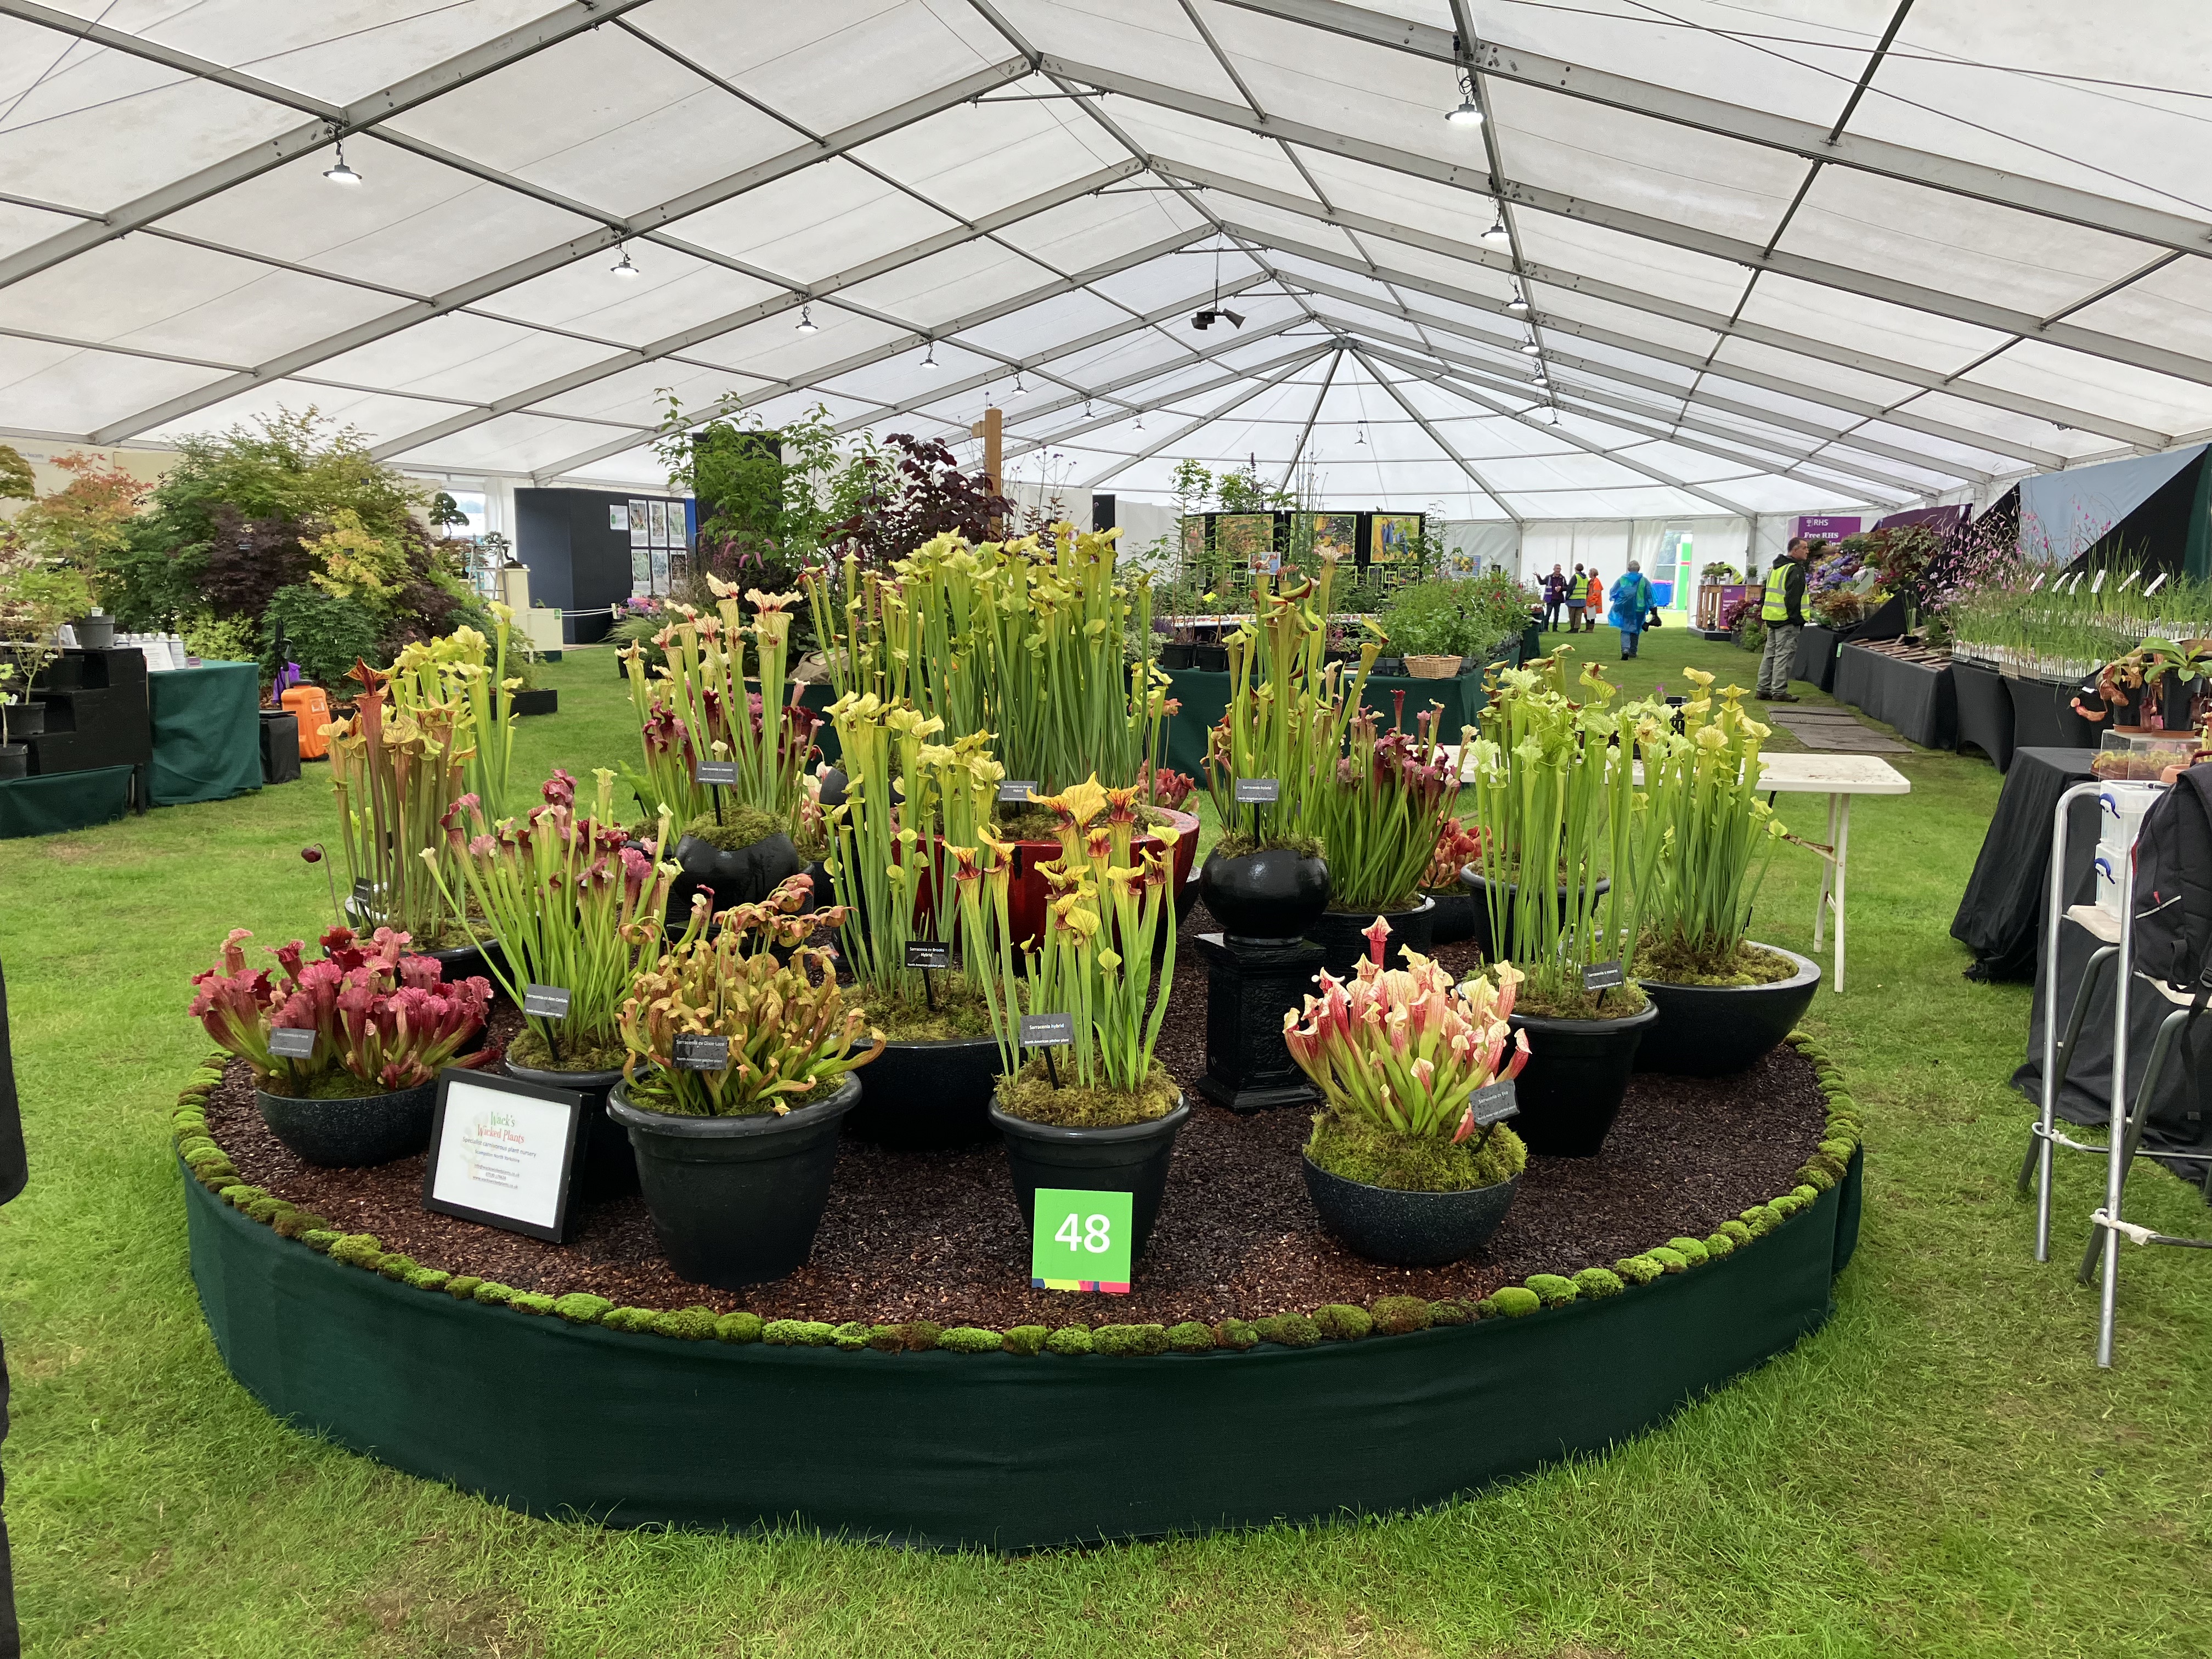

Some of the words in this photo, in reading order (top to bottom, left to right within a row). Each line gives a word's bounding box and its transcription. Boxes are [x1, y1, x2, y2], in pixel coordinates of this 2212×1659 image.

[1479, 1094, 1497, 1104] Sarracenia
[491, 1111, 515, 1127] Wack's
[478, 1124, 501, 1138] Wicked
[503, 1130, 524, 1144] Plants
[462, 1137, 482, 1145] Specialist
[483, 1142, 507, 1150] carnivorous
[520, 1149, 537, 1158] nursery
[1054, 1214, 1110, 1253] 48
